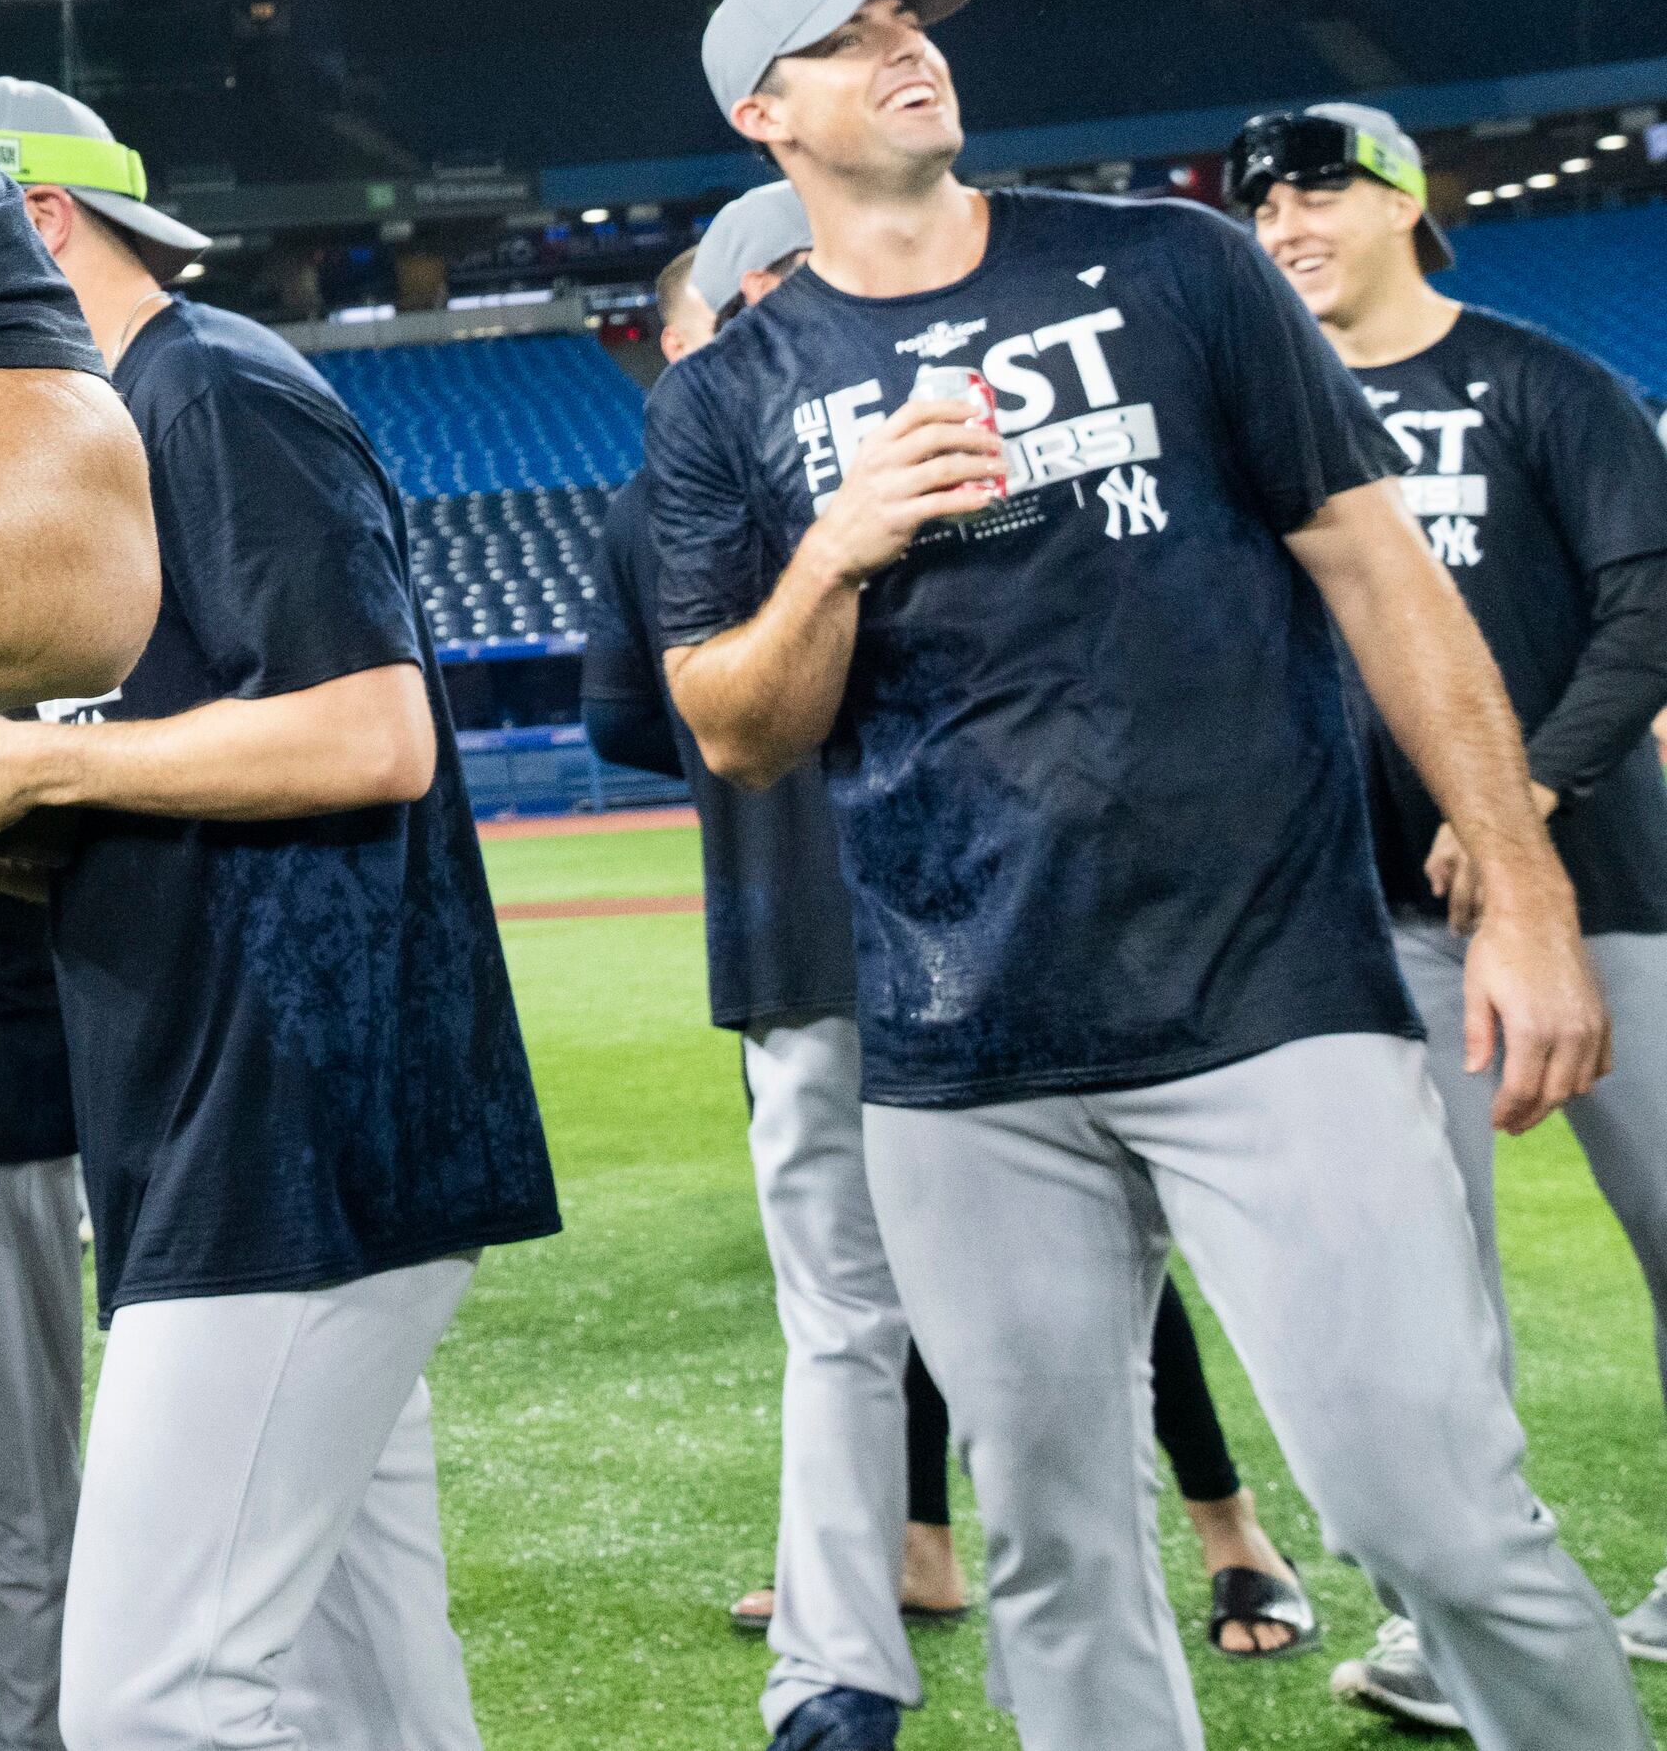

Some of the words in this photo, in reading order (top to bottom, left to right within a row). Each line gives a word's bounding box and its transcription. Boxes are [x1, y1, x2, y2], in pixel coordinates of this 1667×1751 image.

[824, 307, 1125, 480] EST
[793, 398, 839, 493] THE
[1008, 413, 1135, 488] URS
[1382, 408, 1484, 474] ST
[1097, 464, 1169, 541] NY
[1429, 515, 1484, 567] NY
